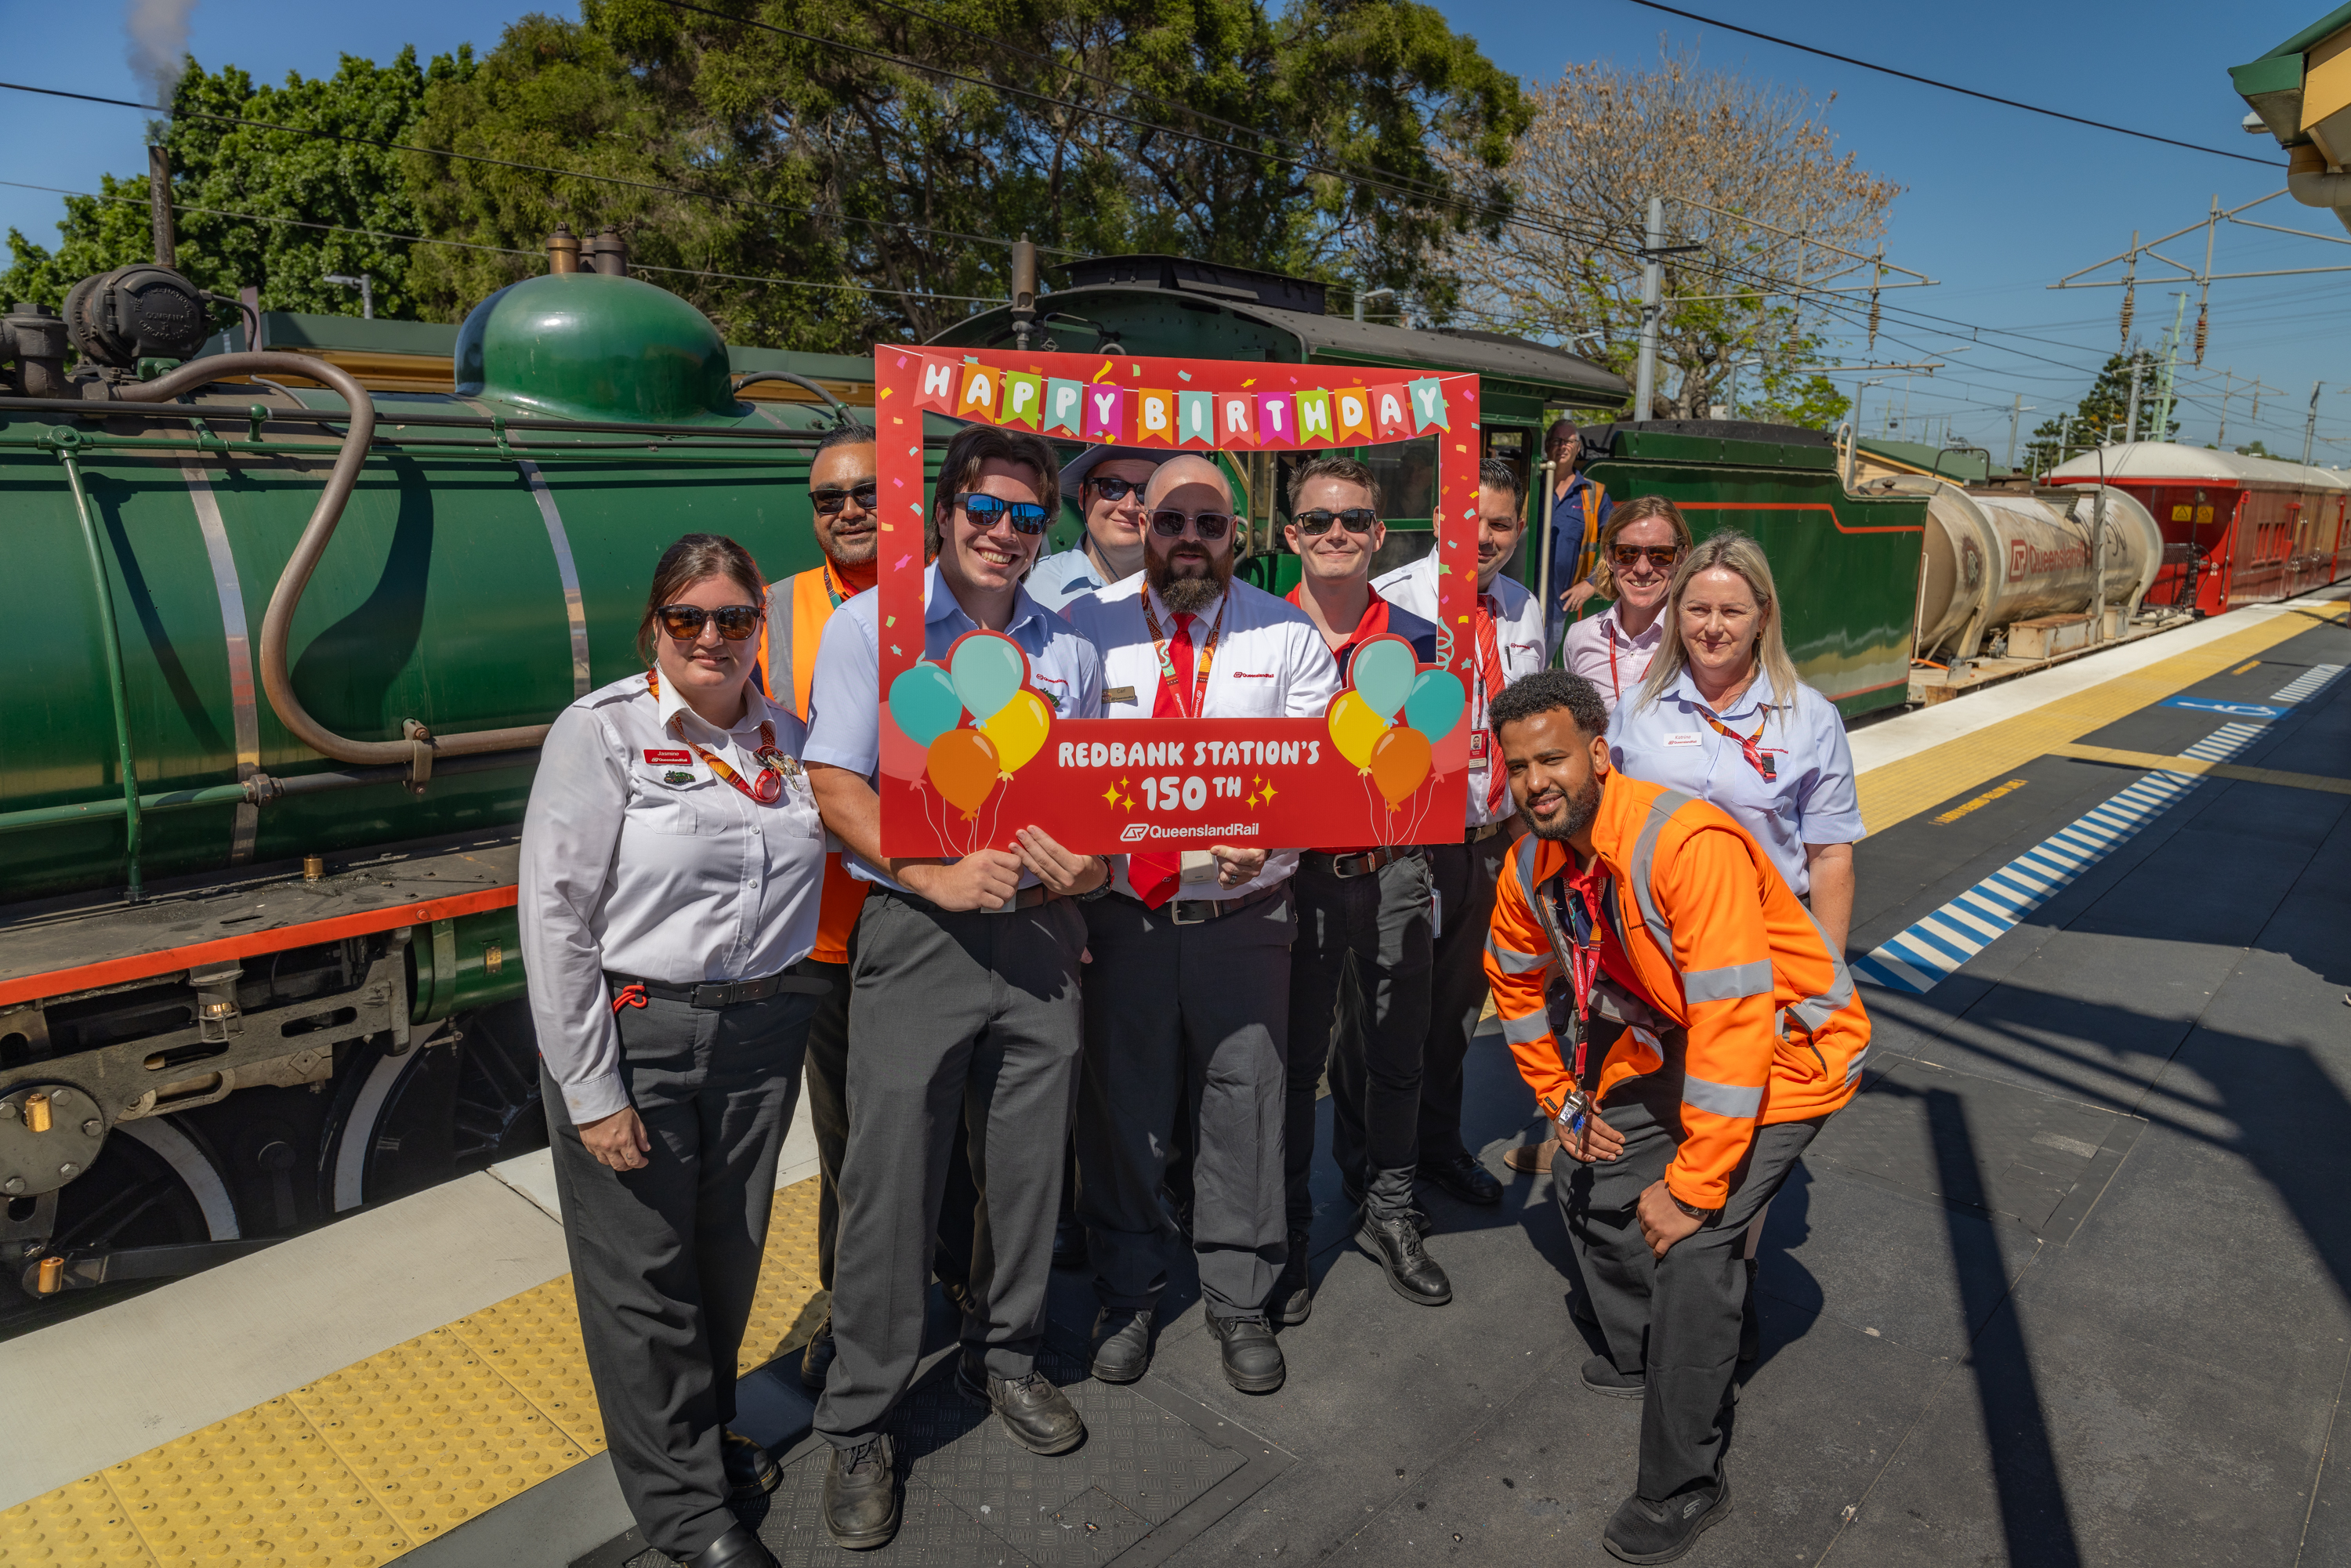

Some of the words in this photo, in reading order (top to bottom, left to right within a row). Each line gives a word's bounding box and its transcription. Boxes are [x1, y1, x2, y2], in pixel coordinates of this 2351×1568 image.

[924, 364, 1115, 425] HAPPY
[1144, 386, 1436, 433] BIRTHDAY
[1058, 741, 1185, 767] REDBANK
[1193, 741, 1320, 766] STATION'S
[1141, 776, 1207, 811] 150
[1212, 776, 1241, 798] TH
[1149, 823, 1259, 838] QueenslandRail
